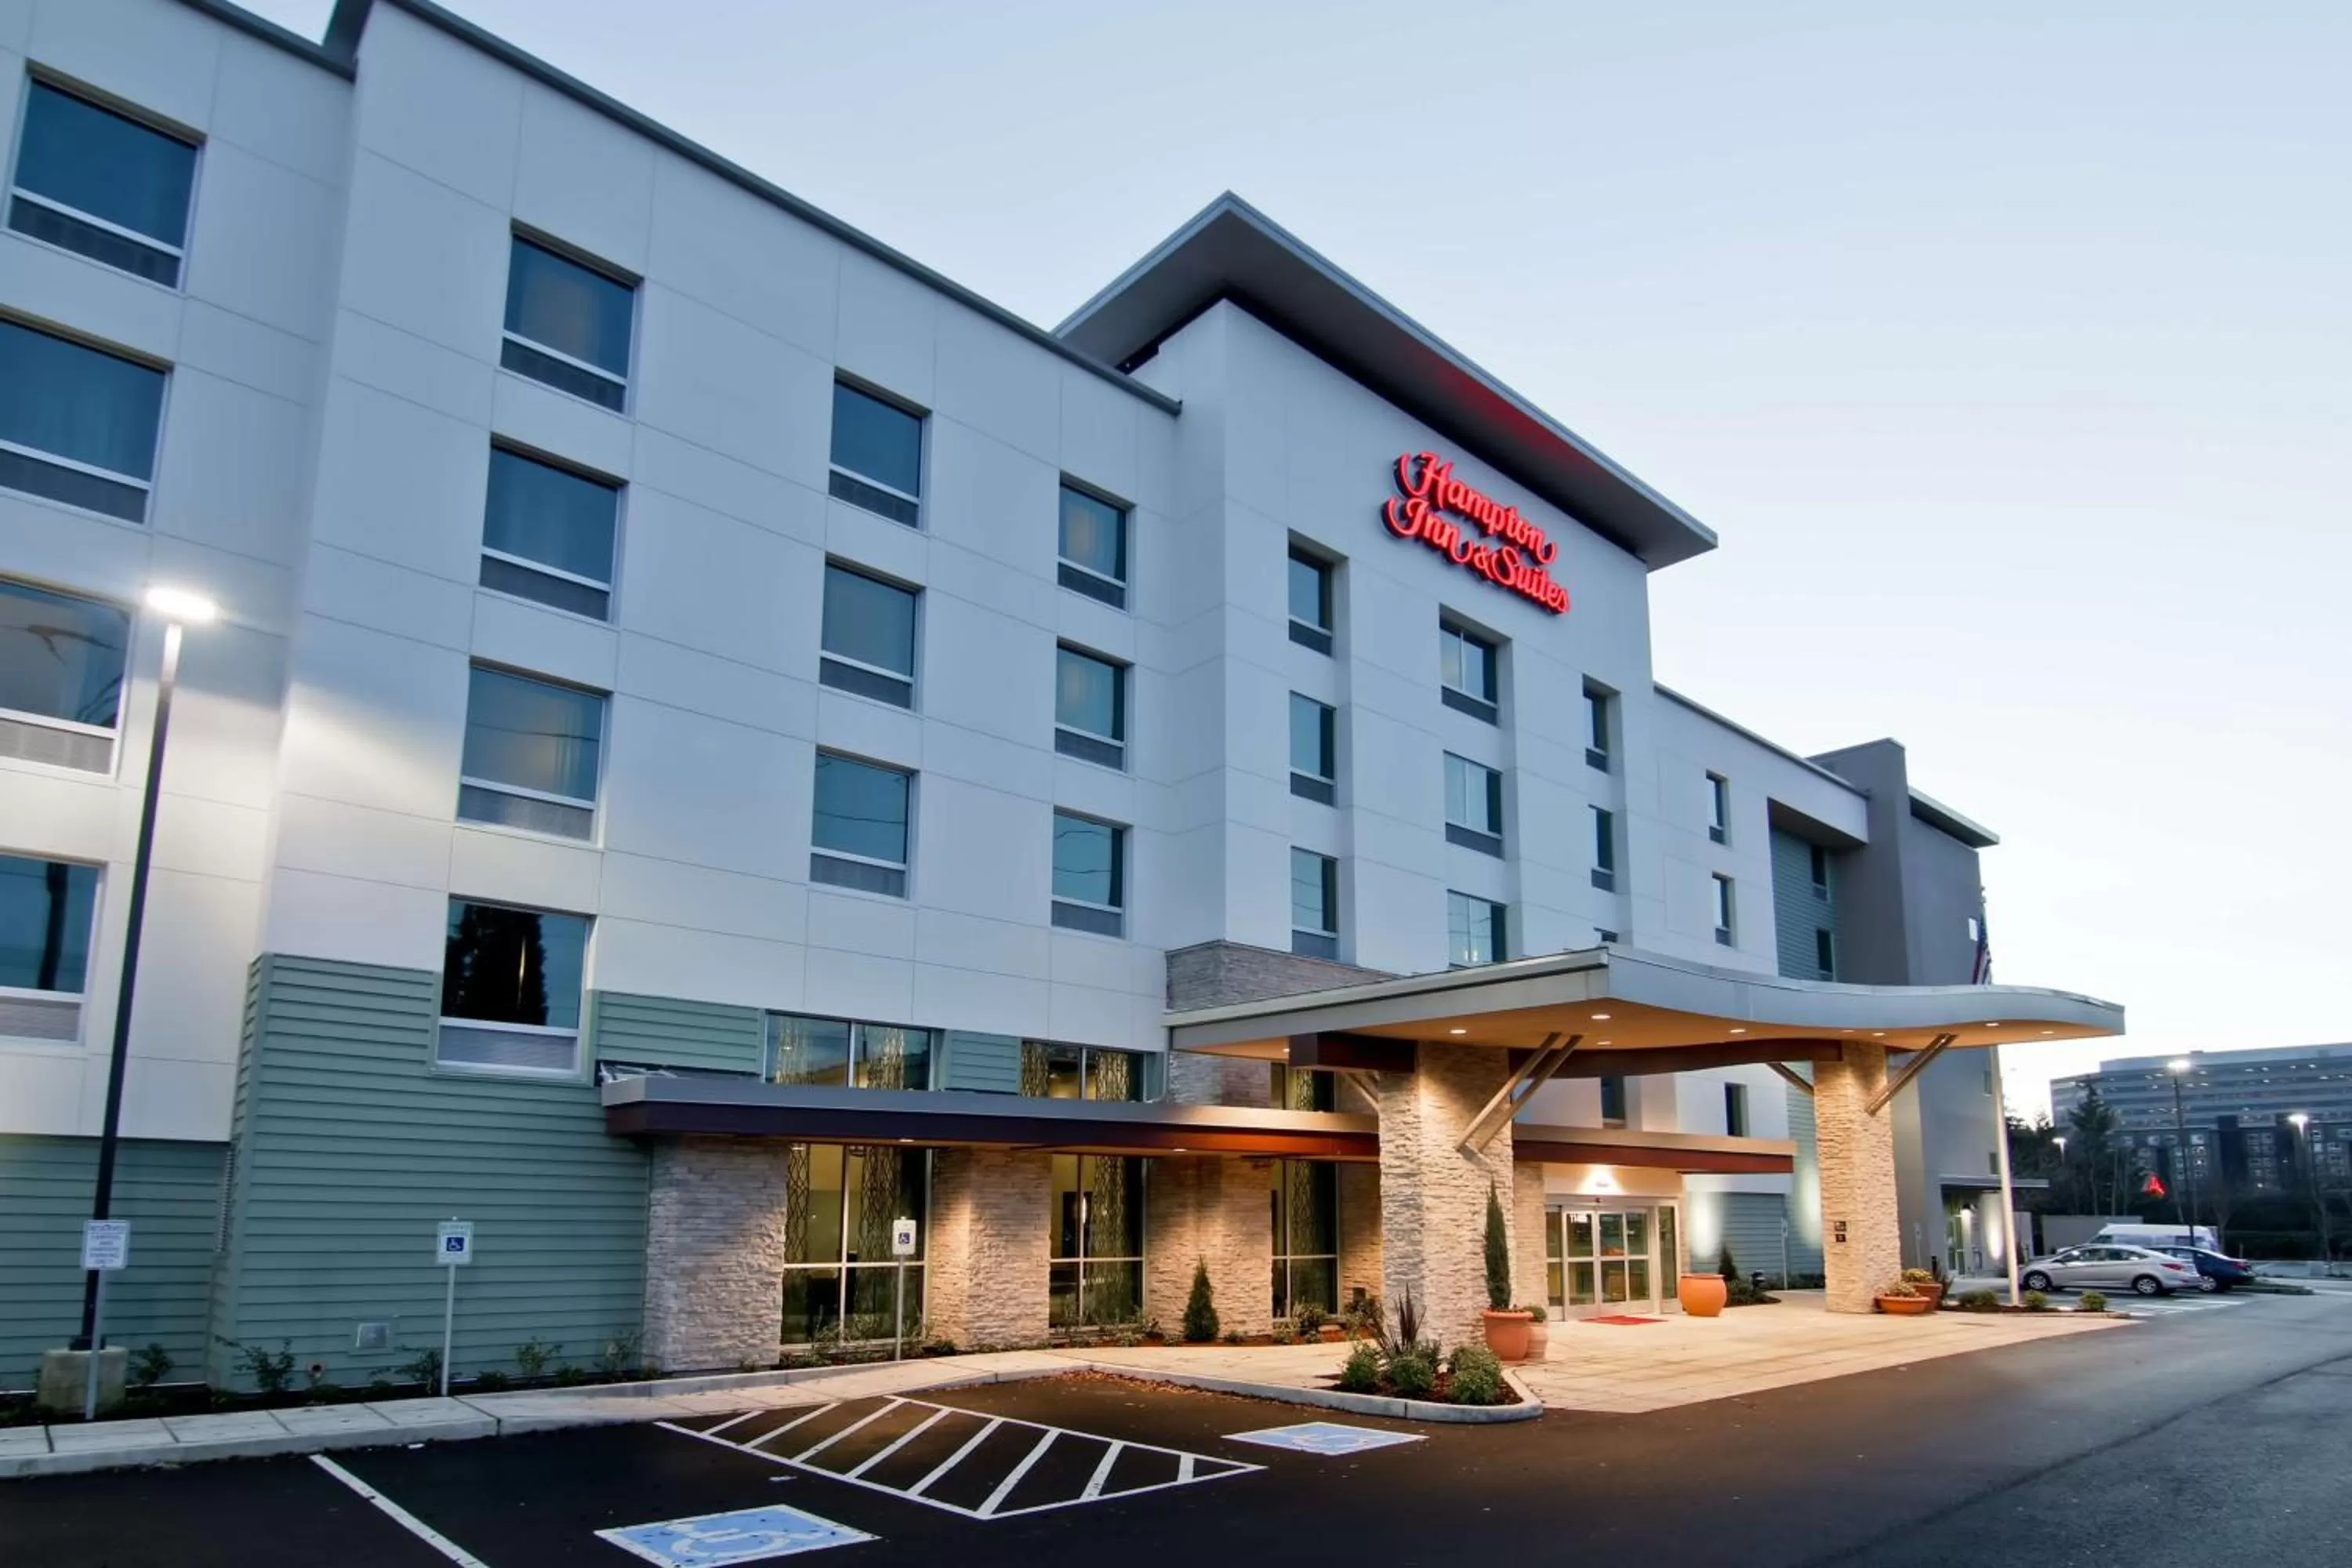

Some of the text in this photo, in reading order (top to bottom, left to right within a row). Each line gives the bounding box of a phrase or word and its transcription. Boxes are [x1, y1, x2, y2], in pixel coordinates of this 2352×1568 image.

[1383, 497, 1474, 564] Inn
[1491, 546, 1570, 614] Suites
[1395, 452, 1558, 566] Hampton
